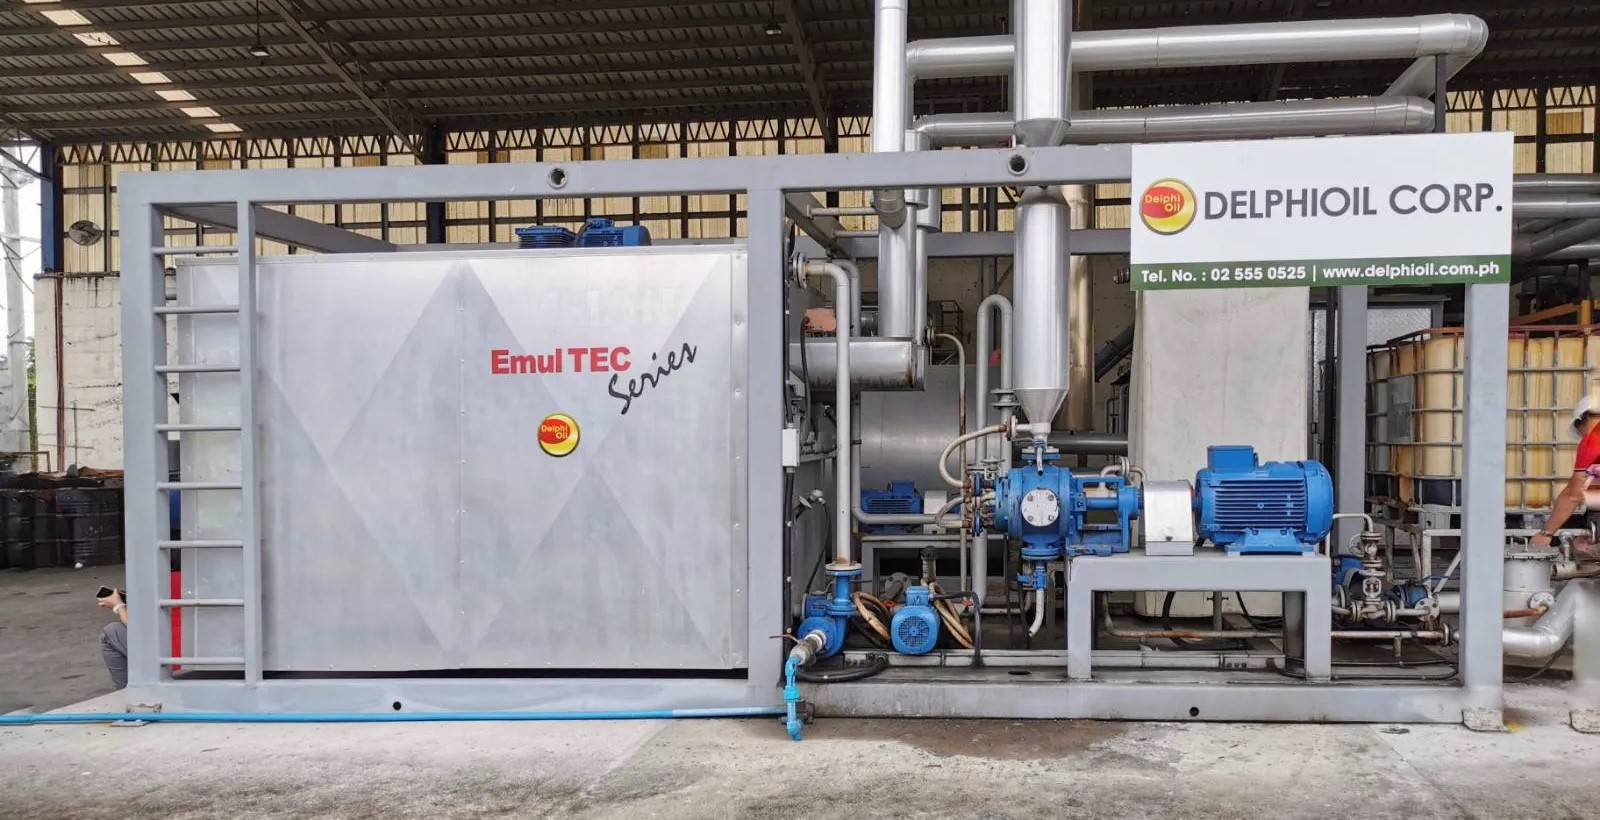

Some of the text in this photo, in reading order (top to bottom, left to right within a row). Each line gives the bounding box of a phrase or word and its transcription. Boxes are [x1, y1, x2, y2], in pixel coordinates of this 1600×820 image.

[1144, 194, 1181, 206] Delphi
[1164, 202, 1181, 212] Oil
[1204, 183, 1503, 220] DELPHIOIL CORP.
[1142, 270, 1167, 283] Tel.
[1172, 269, 1196, 282] No.
[1210, 268, 1230, 281] 02
[1234, 267, 1263, 281] 555
[1268, 266, 1306, 280] 0525
[1323, 262, 1500, 280] www.delphioil.com.ph
[491, 346, 631, 374] Emul TEC
[608, 342, 697, 415] Series
[541, 425, 568, 434] Delphi
[556, 432, 568, 440] Oil
